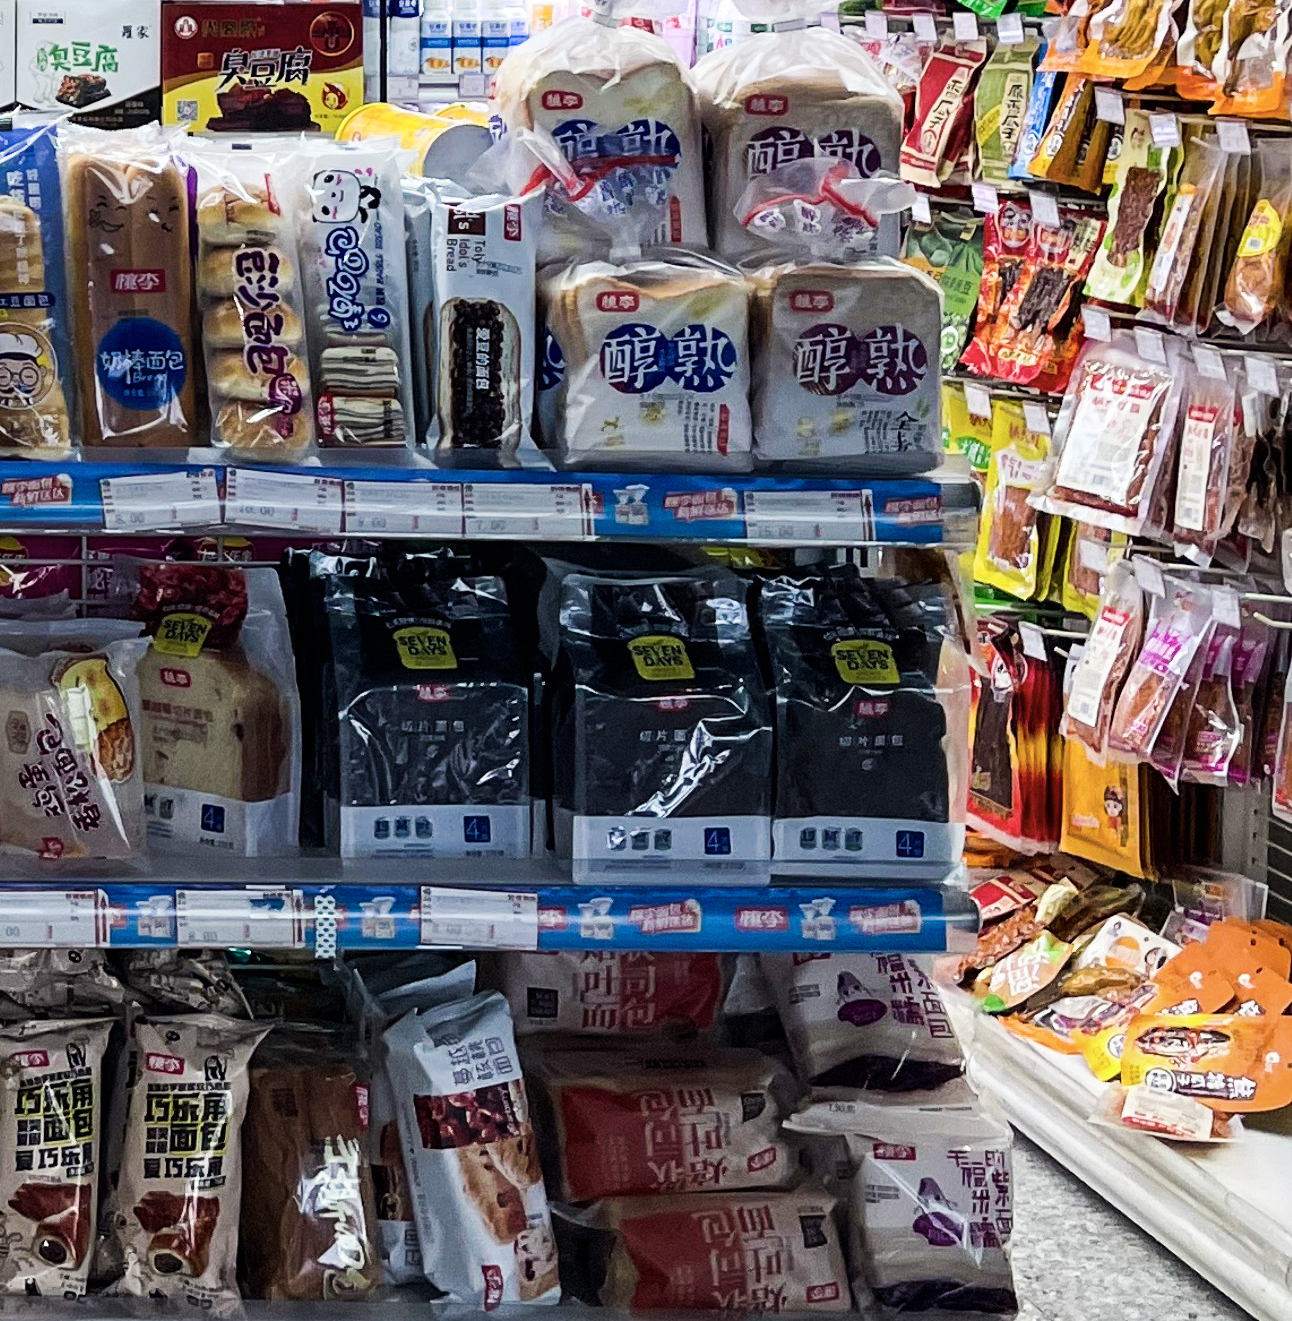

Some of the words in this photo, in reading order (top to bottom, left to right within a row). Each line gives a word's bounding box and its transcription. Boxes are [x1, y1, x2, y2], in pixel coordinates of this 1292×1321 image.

[50, 41, 119, 72] 臭豆腐
[215, 45, 313, 92] 臭豆腐
[447, 239, 458, 272] Bread
[115, 273, 159, 290] 桃李
[603, 323, 737, 389] 醇熟
[796, 323, 928, 391] 醇熟
[398, 636, 447, 647] SEVEN
[408, 646, 447, 656] DAYS
[632, 645, 683, 657] SEVEN
[836, 649, 889, 660] SEVEN
[643, 656, 683, 667] DAYS
[847, 660, 889, 671] DAYS
